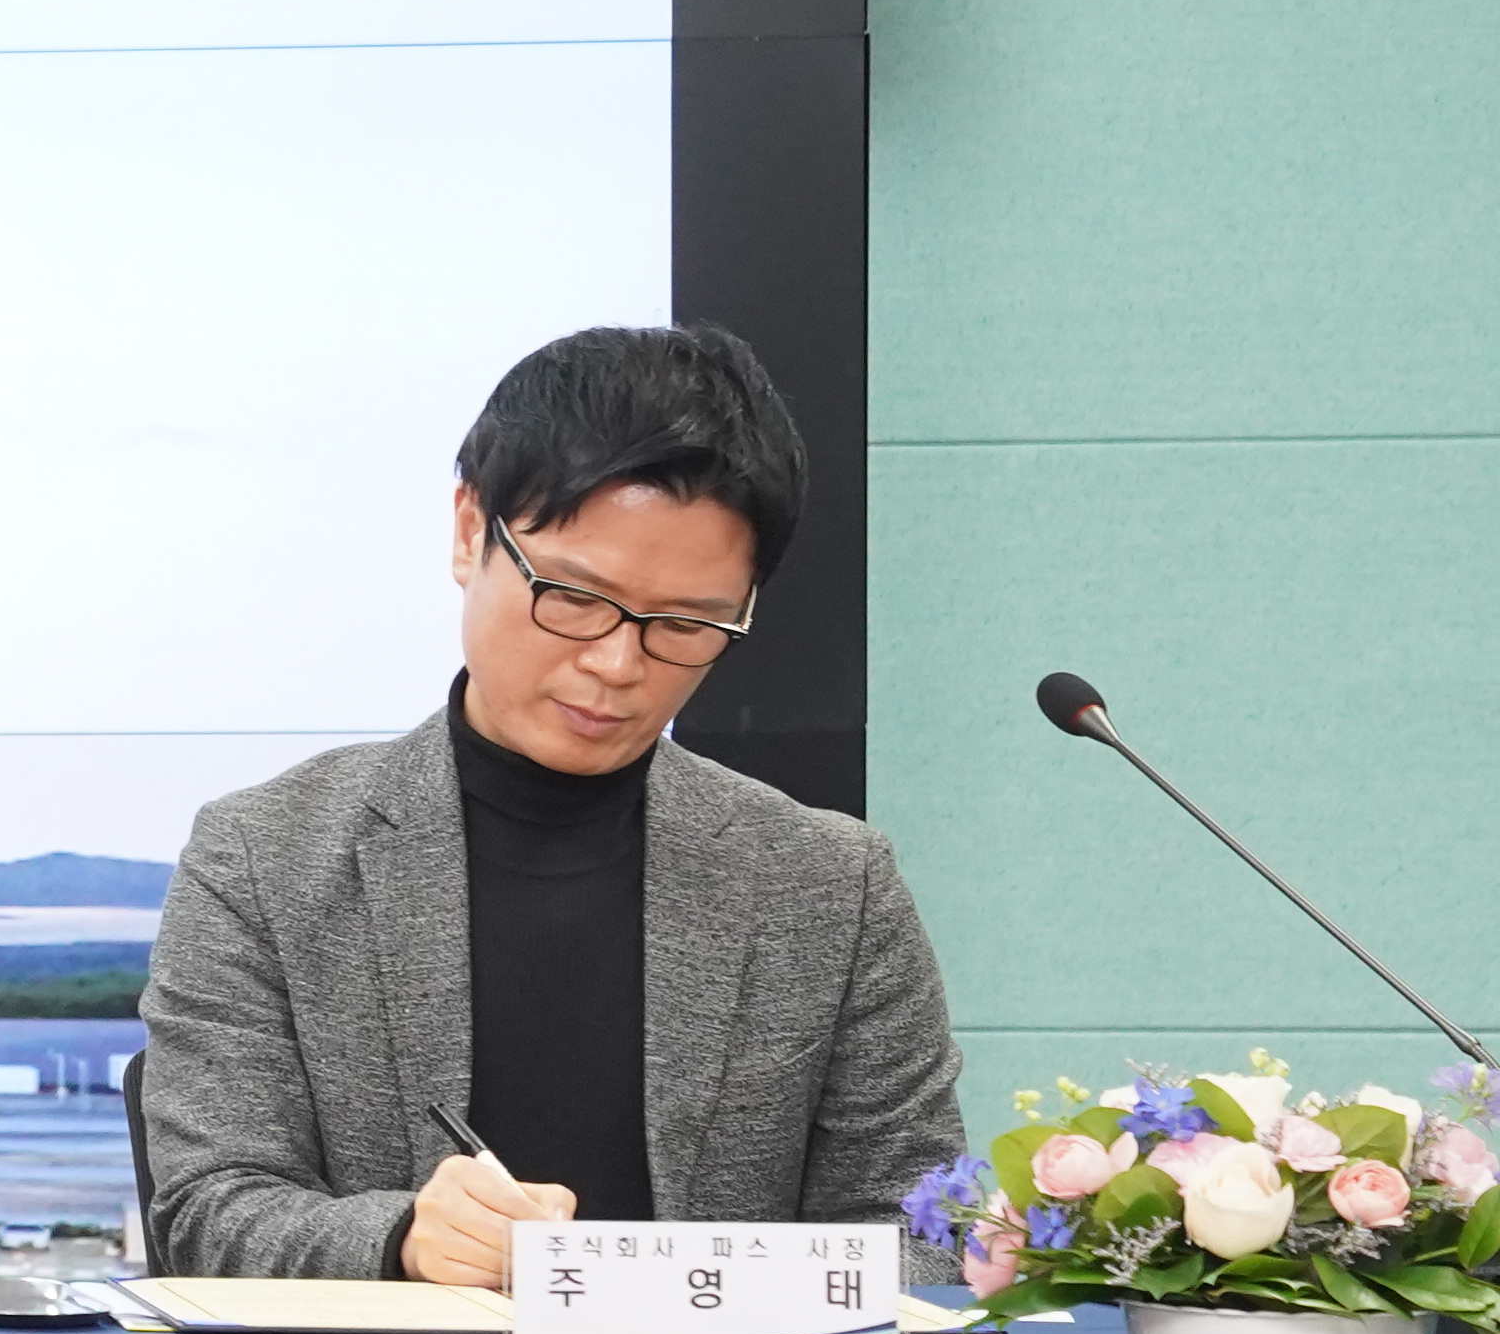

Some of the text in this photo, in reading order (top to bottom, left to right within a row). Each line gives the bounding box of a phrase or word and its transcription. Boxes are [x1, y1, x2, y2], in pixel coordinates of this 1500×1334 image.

[546, 1236, 865, 1261] 주식회사 파스 사장
